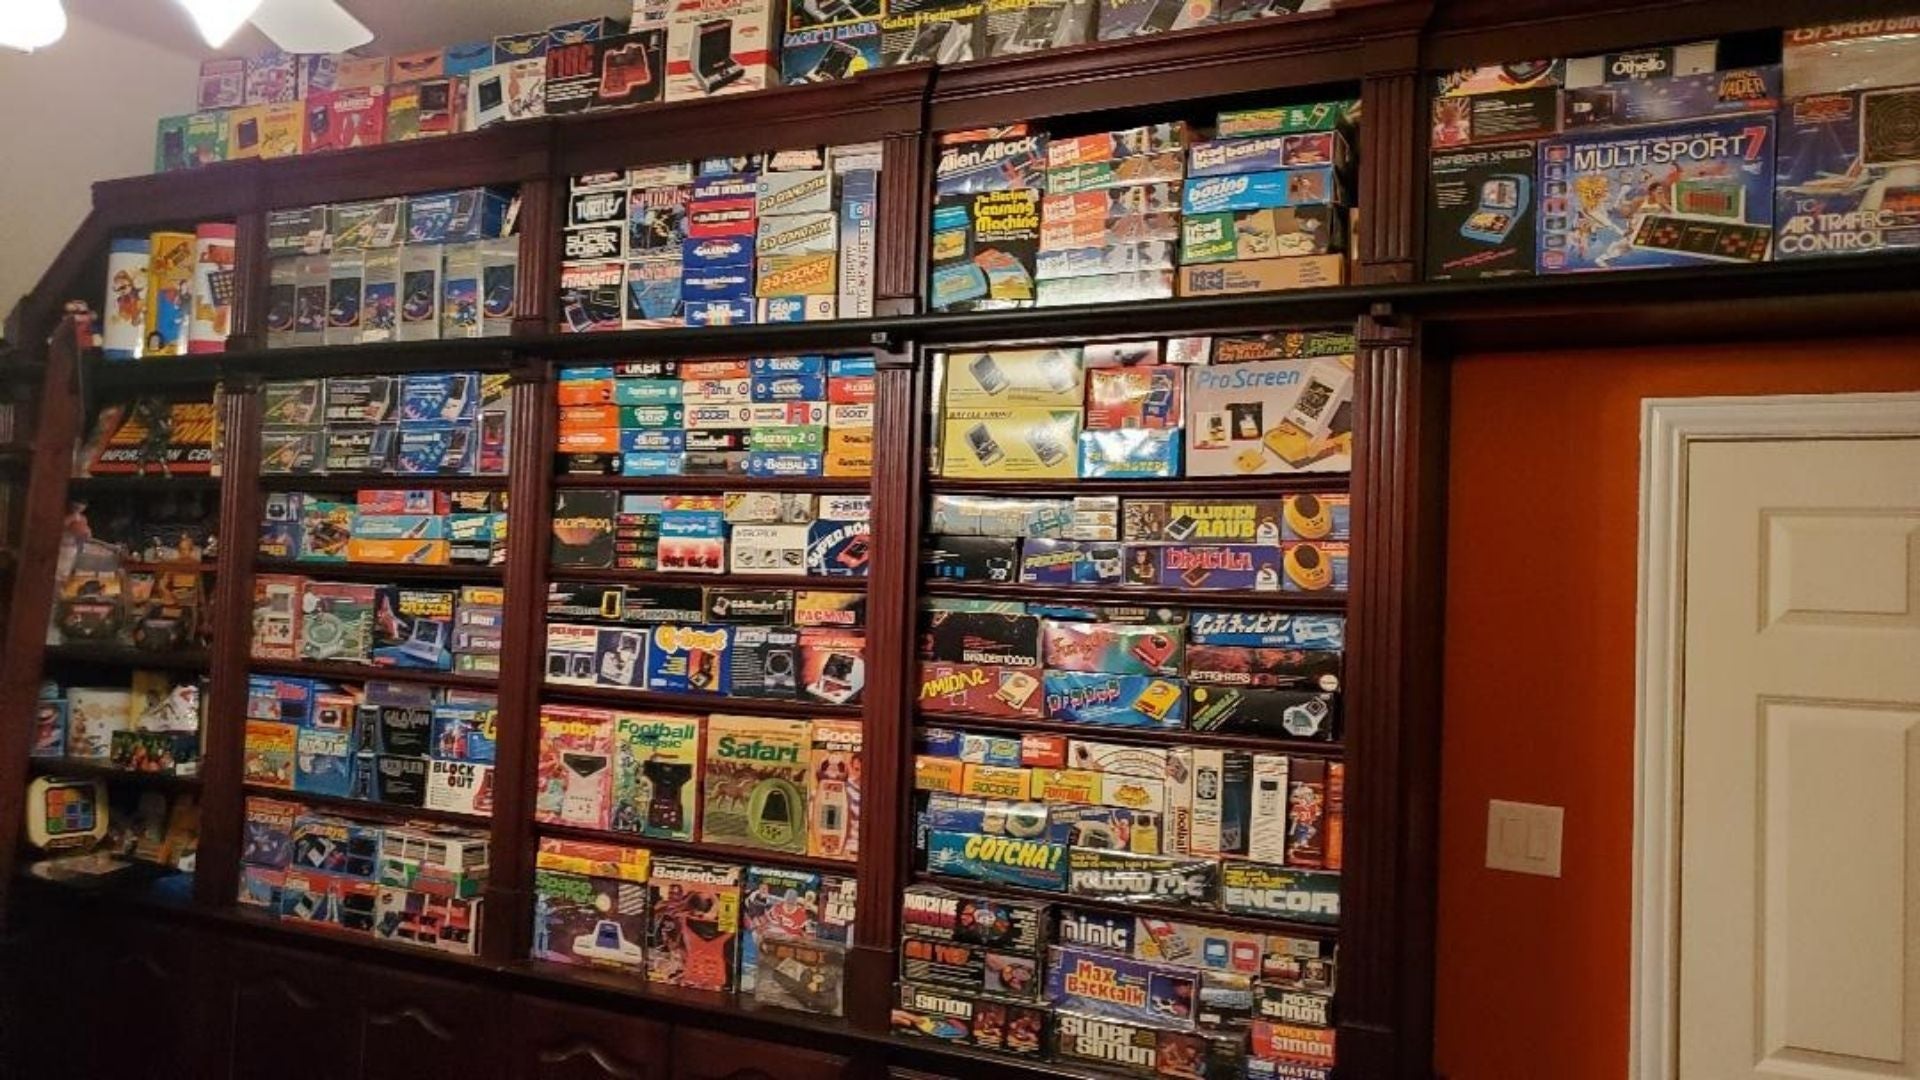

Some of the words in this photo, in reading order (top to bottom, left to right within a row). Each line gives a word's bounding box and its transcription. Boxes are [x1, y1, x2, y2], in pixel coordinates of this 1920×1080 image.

[1612, 59, 1666, 75] Othello
[937, 151, 981, 173] Alien
[980, 135, 1038, 162] Attack
[1574, 136, 1746, 172] MULTI-SPORT
[1742, 125, 1767, 161] 7
[974, 201, 1035, 217] Learning
[976, 215, 1039, 232] Machine
[1780, 215, 1816, 236] AIR
[1779, 230, 1887, 253] CONTROL
[1197, 371, 1231, 389] Pro
[1231, 368, 1301, 389] Screen
[618, 718, 696, 740] Football
[717, 736, 799, 763] Safari
[433, 761, 476, 777] BLOCK
[447, 775, 475, 789] OUT
[972, 780, 1020, 796] SOCCER
[964, 834, 1063, 872] GOTCHA!
[652, 865, 736, 886] Basketball
[1076, 959, 1116, 984] Max
[1065, 973, 1147, 1008] Backtalk
[1076, 1036, 1157, 1067] simon
[1278, 1064, 1327, 1080] MASTER
